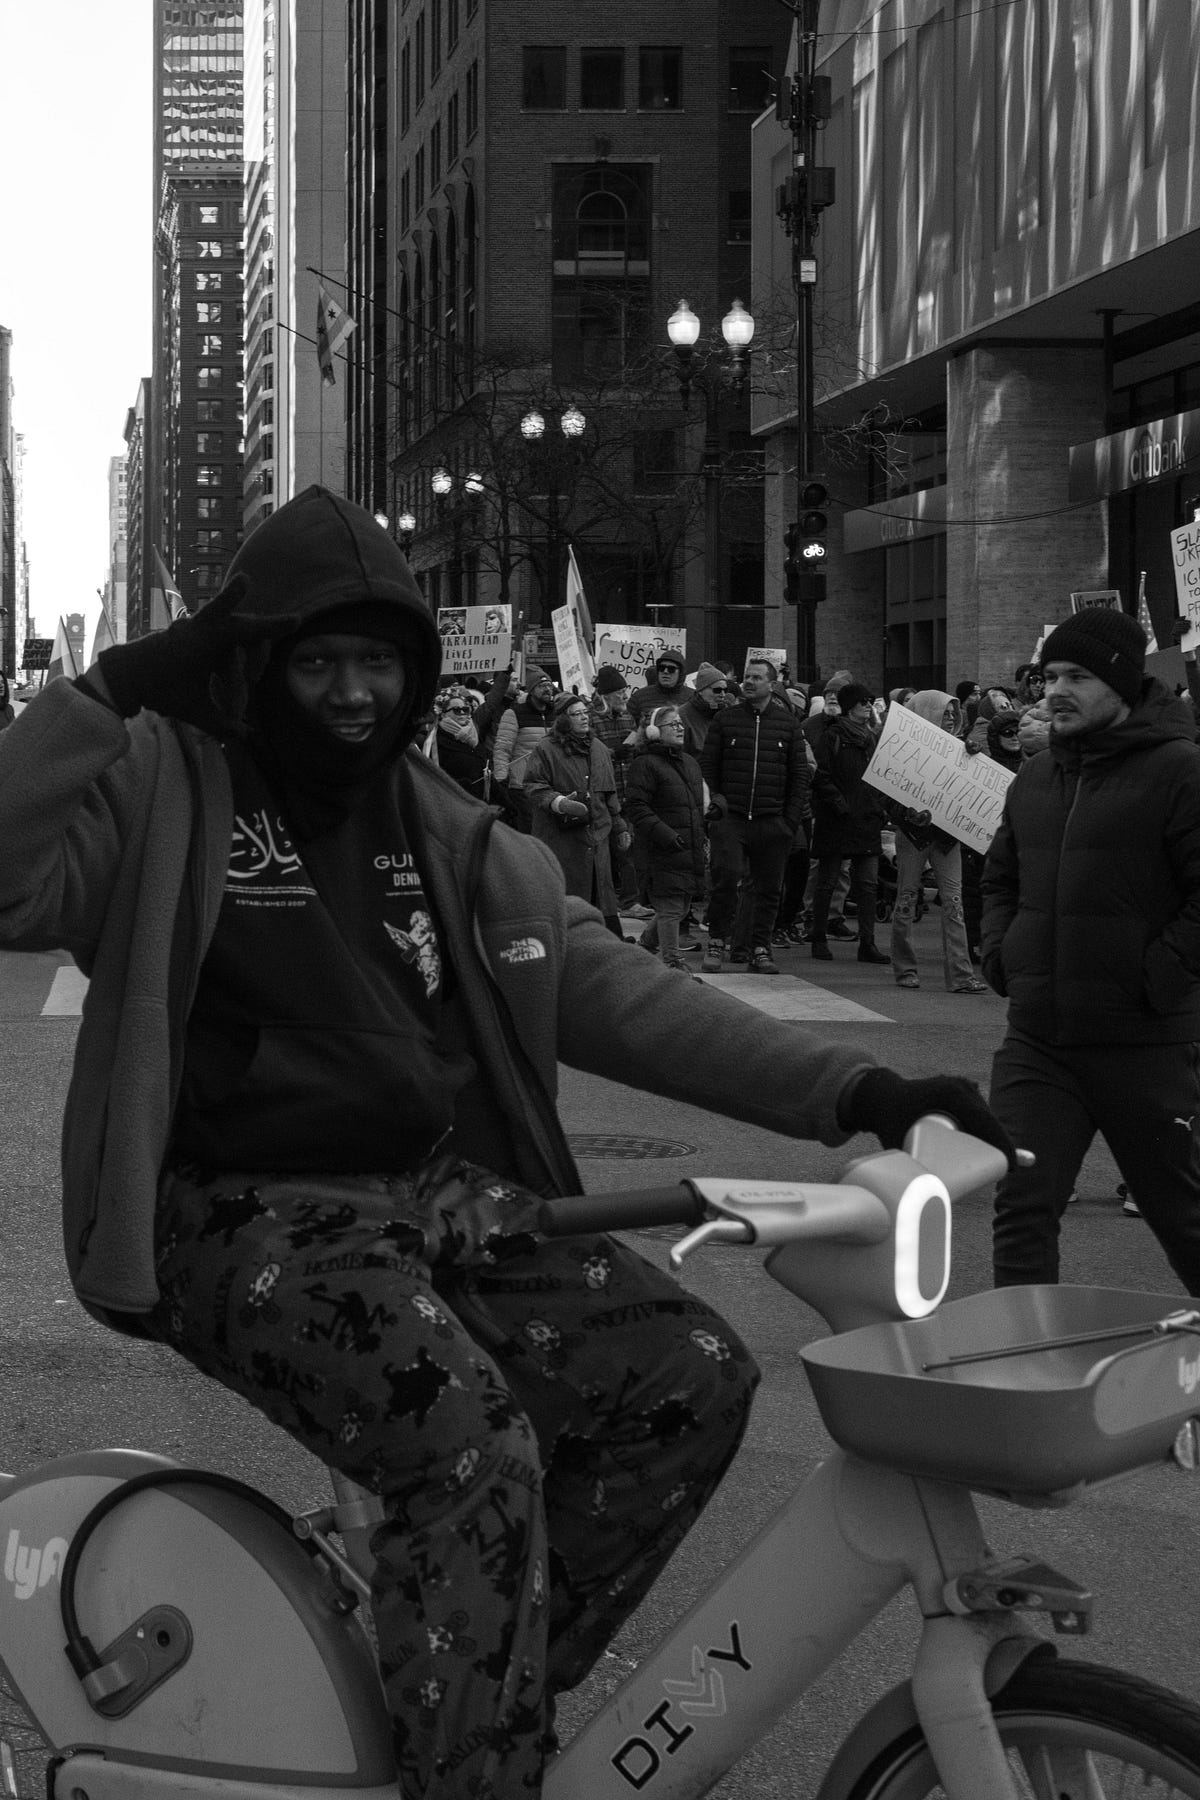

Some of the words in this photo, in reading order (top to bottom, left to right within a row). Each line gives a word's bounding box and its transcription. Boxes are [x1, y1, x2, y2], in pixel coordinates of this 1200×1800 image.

[1130, 434, 1187, 482] citibank
[621, 644, 655, 665] USA
[879, 732, 929, 778] REAL
[896, 710, 955, 760] TRUMP
[953, 747, 972, 772] IS
[970, 757, 1011, 798] THE
[945, 800, 989, 842] Ukraine
[500, 946, 530, 959] NORTH
[509, 952, 530, 963] FACE
[511, 939, 528, 948] THE
